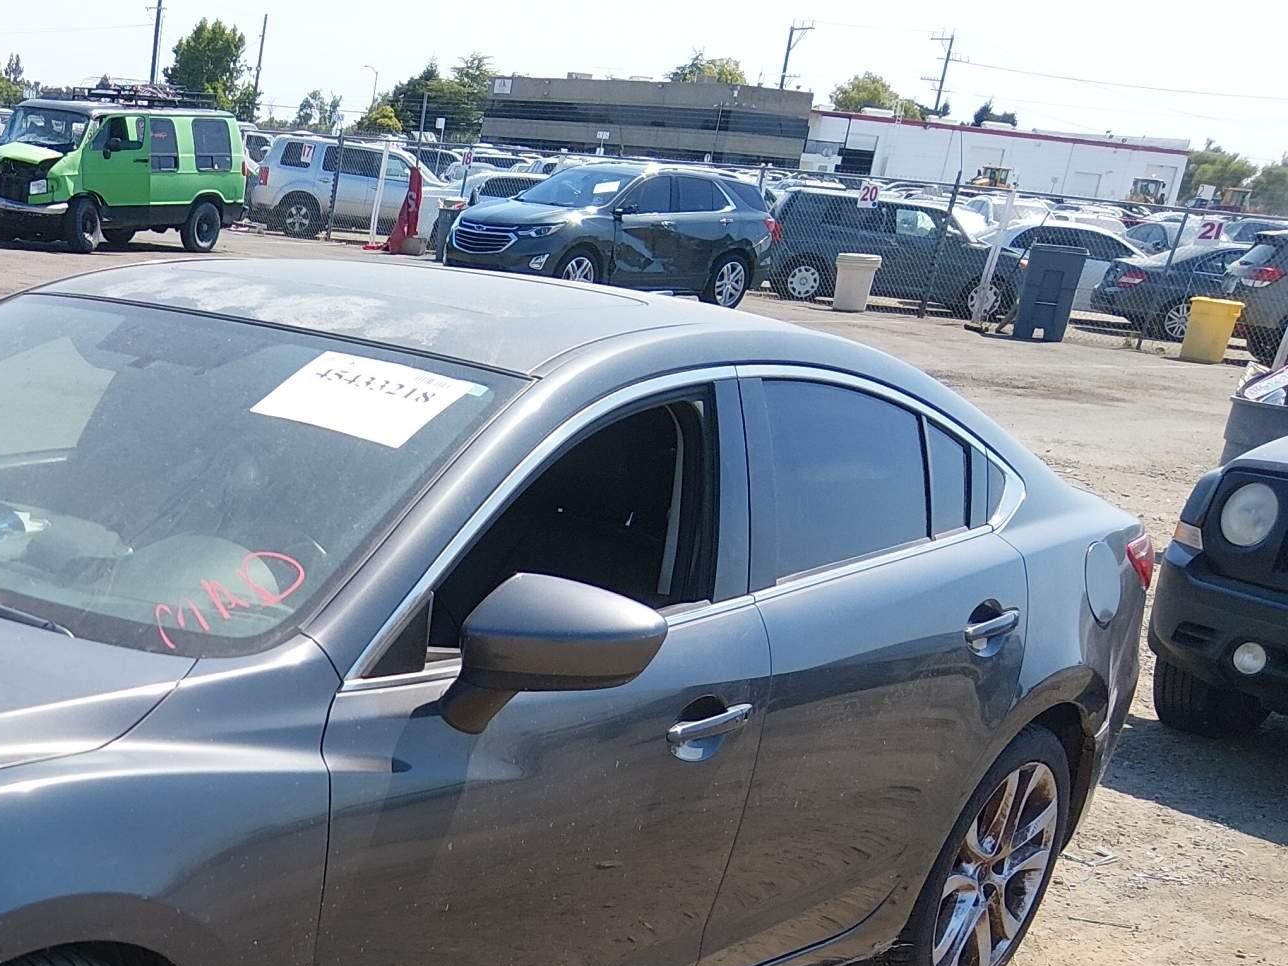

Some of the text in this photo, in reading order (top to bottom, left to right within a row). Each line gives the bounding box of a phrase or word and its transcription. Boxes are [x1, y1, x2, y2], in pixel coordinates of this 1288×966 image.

[302, 144, 313, 158] 17
[462, 151, 472, 166] 18
[860, 186, 878, 202] 20
[1198, 222, 1224, 240] 21
[315, 368, 436, 403] 45433218
